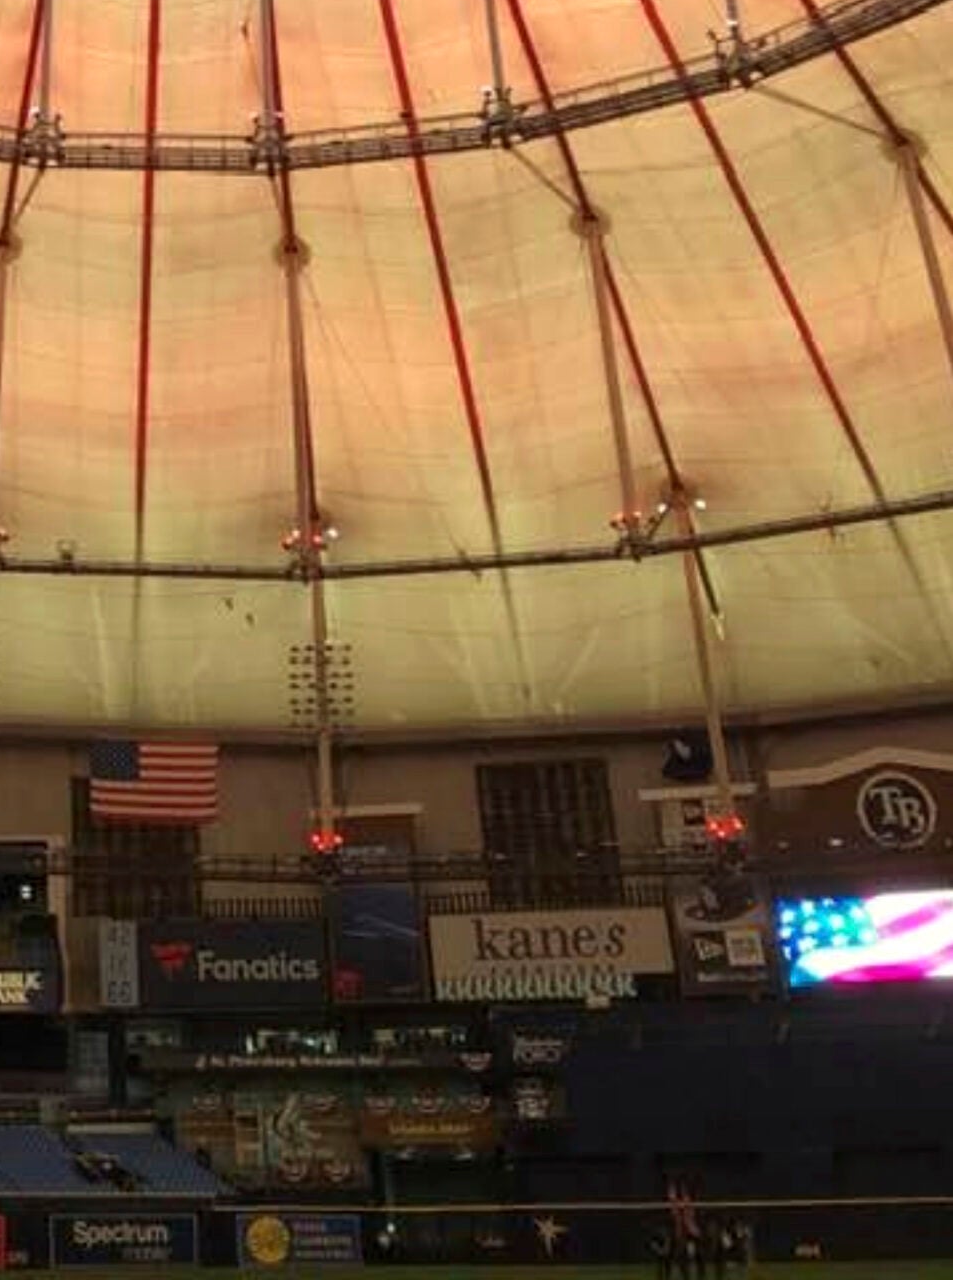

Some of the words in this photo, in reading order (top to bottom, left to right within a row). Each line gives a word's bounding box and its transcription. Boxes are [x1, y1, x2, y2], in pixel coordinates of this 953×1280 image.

[869, 786, 925, 834] TB
[197, 950, 319, 982] Fanatics
[72, 1220, 168, 1248] Spectrum
